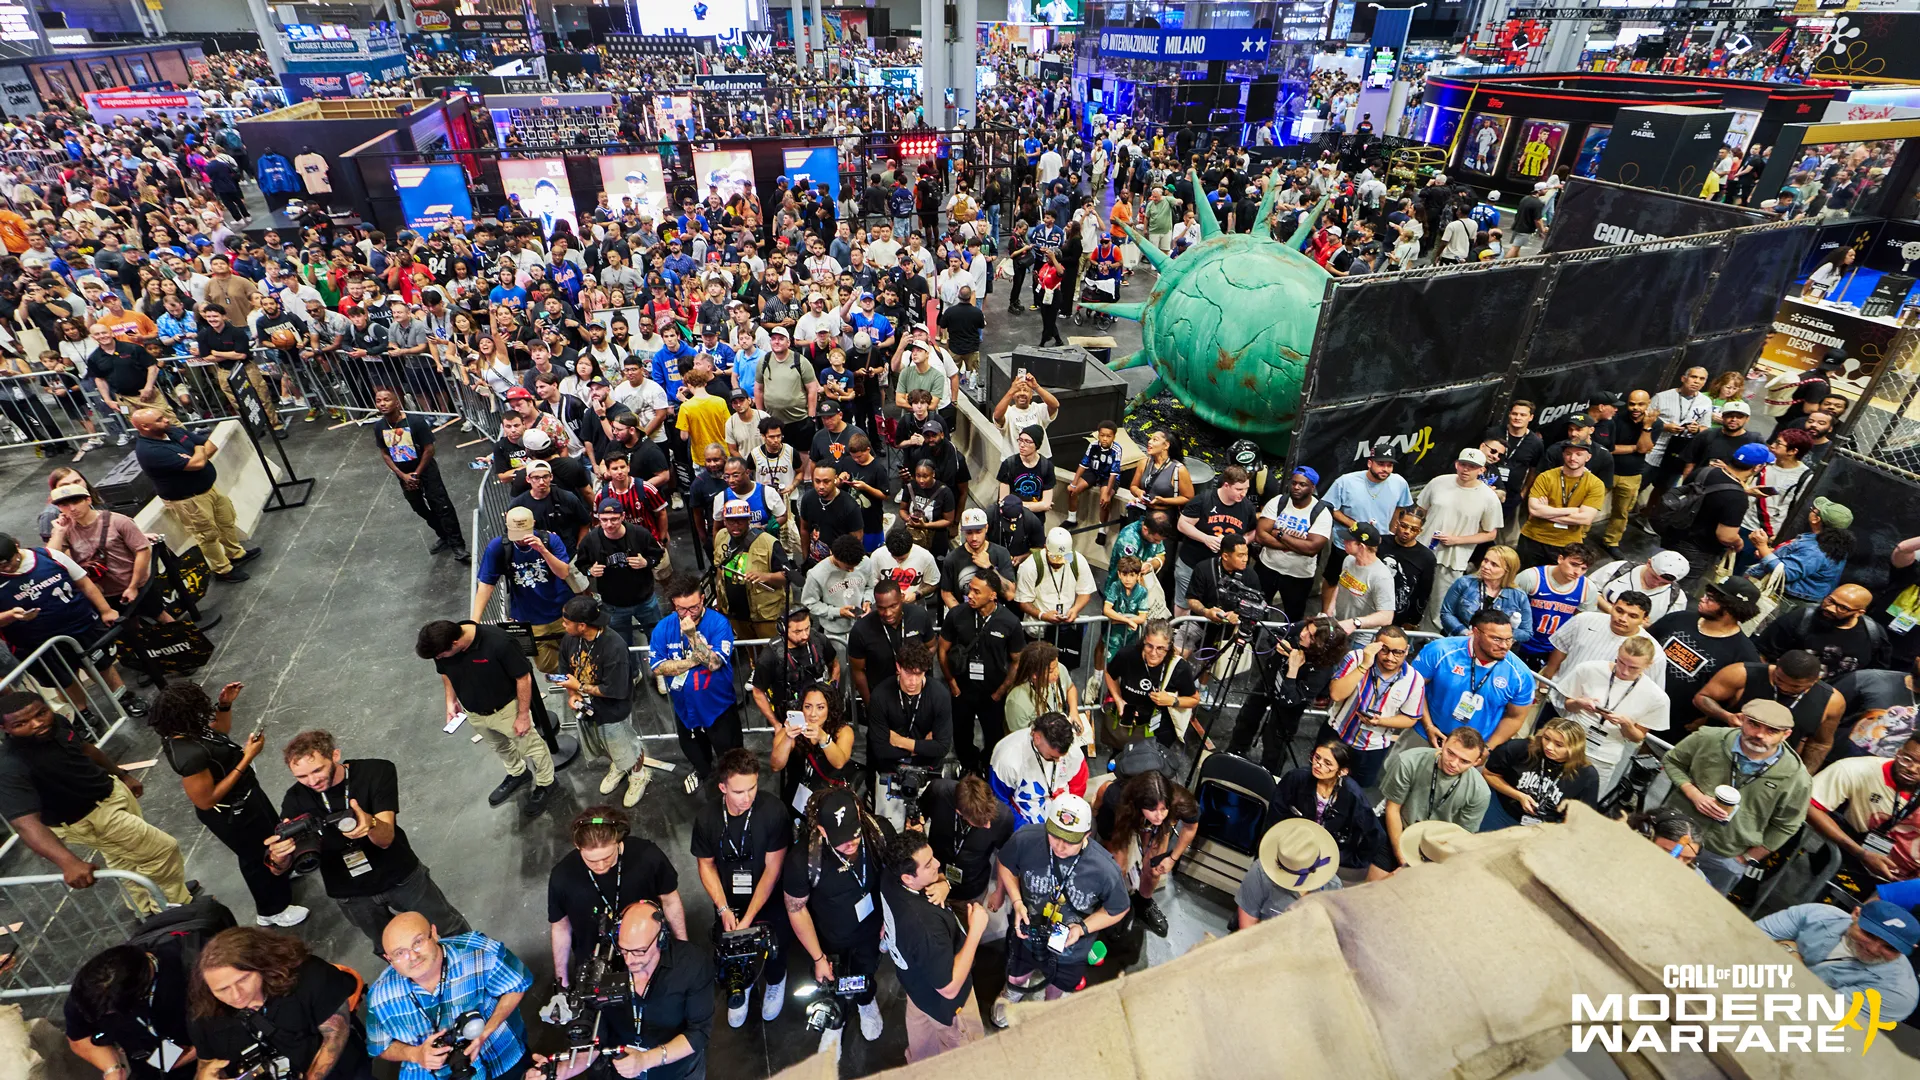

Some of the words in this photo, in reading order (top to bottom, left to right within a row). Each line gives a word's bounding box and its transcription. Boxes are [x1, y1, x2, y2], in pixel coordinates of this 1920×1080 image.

[321, 41, 354, 49] SELECTION
[1109, 33, 1159, 54] INTERNAZIONALE
[1165, 36, 1206, 54] MILANO
[101, 98, 150, 107] FRANCHISE
[151, 97, 173, 105] WITH
[1631, 130, 1656, 139] PADEL
[1593, 222, 1634, 245] CALL
[1632, 234, 1645, 243] OF
[428, 257, 447, 276] 84
[369, 308, 392, 320] DALLAS
[1800, 317, 1836, 332] PADEL
[1772, 321, 1845, 349] REGISTRATION
[1786, 337, 1816, 353] DESK
[760, 465, 788, 476] LAKERS
[1206, 514, 1225, 524] NEW
[1224, 515, 1242, 529] YORK
[13, 573, 62, 601] BROTHERLY
[1530, 599, 1552, 611] NEW
[1551, 602, 1575, 615] YORK
[1535, 614, 1560, 635] 11
[160, 642, 191, 656] DUTY
[1668, 646, 1697, 667] LOYALTY
[1672, 642, 1700, 662] HUSTLE
[1664, 649, 1694, 672] RESPECT
[693, 669, 712, 691] 17
[1125, 685, 1146, 696] PROJECT
